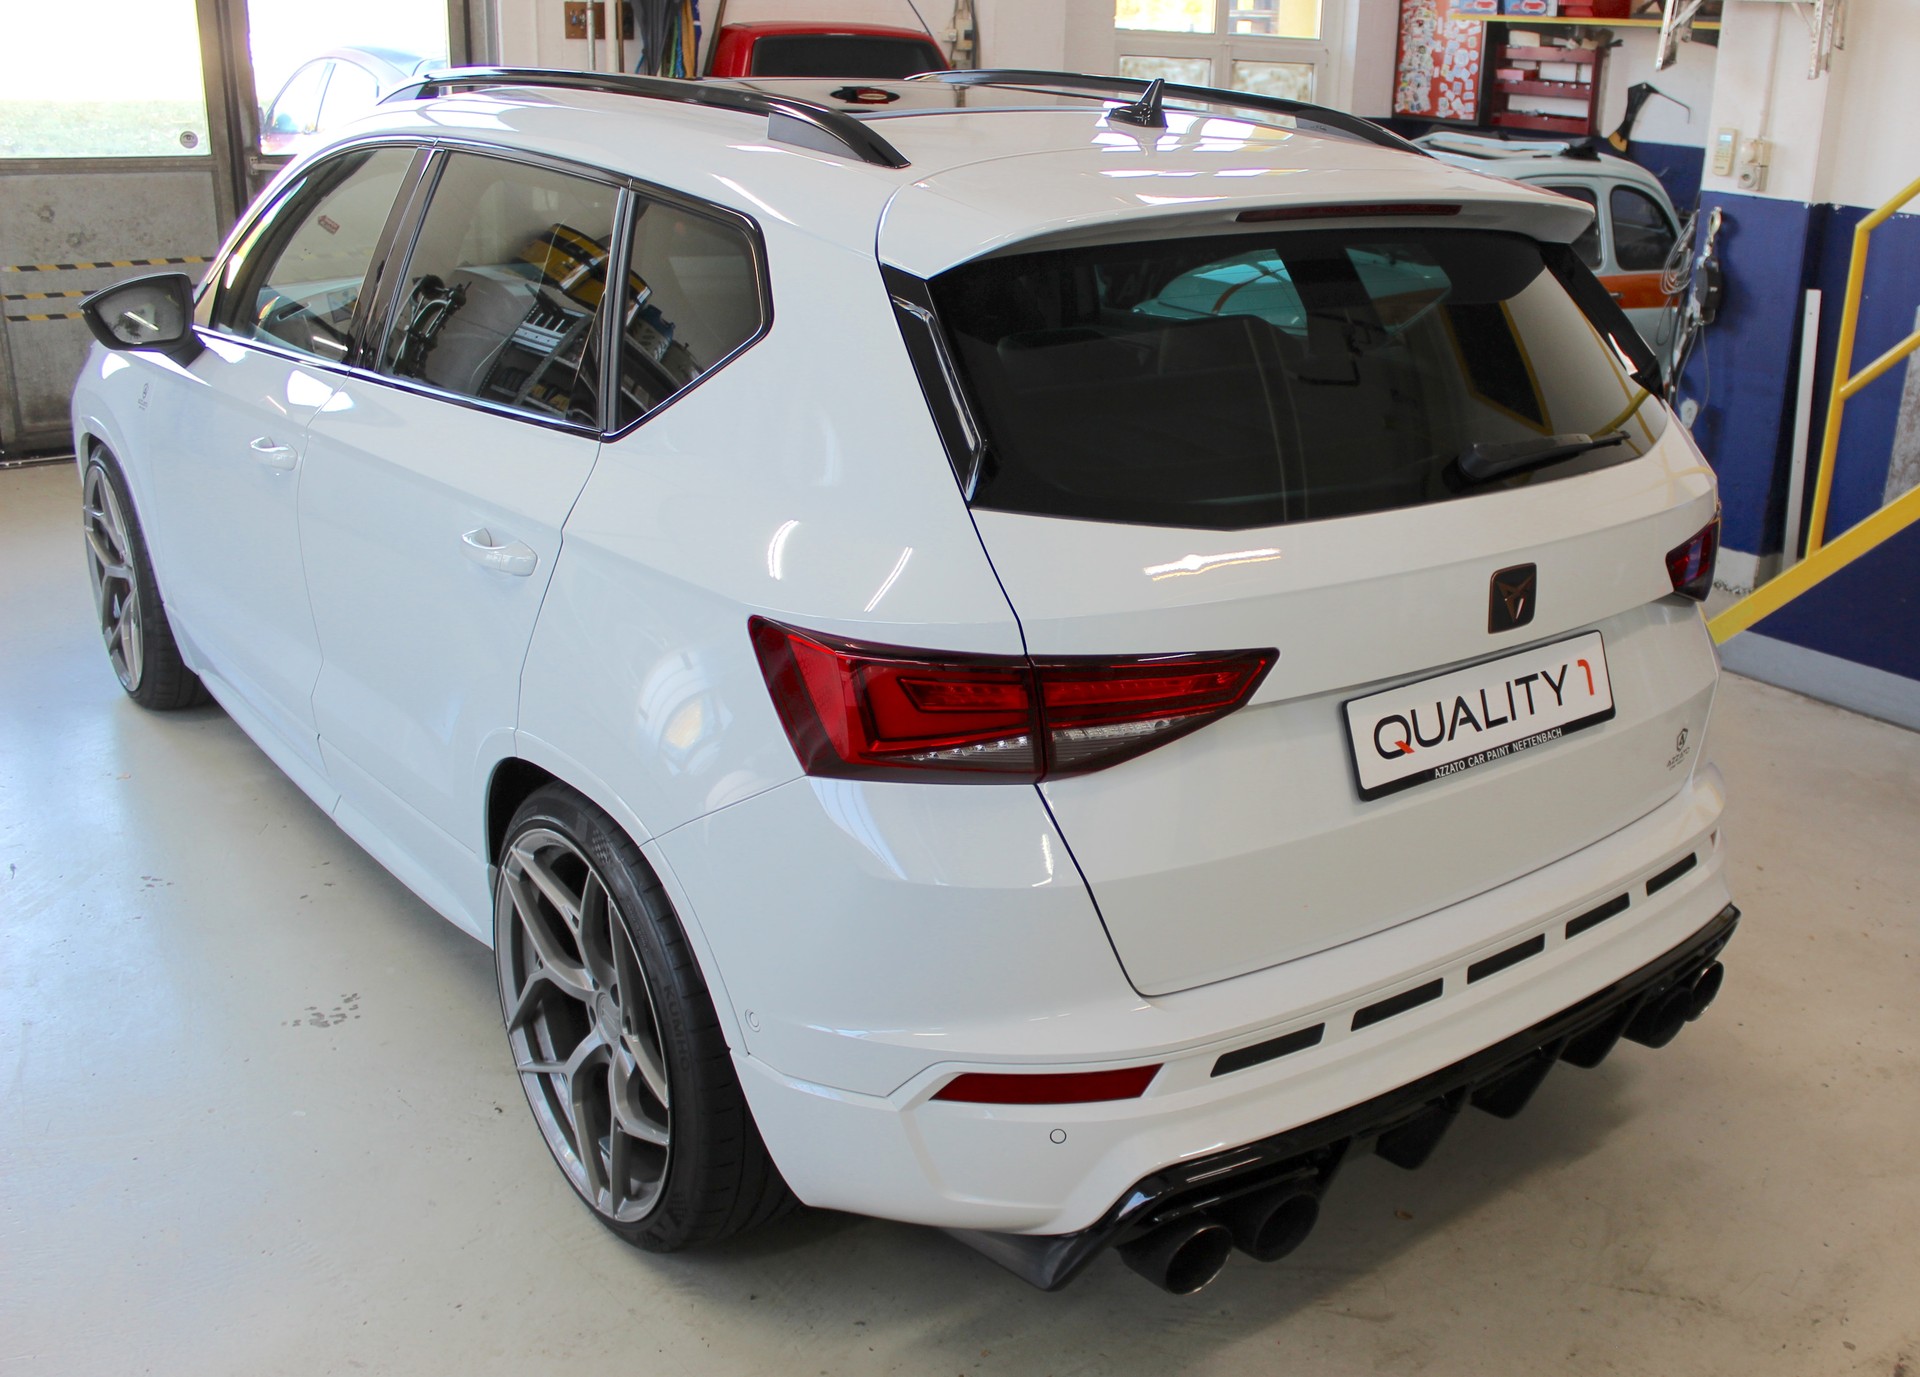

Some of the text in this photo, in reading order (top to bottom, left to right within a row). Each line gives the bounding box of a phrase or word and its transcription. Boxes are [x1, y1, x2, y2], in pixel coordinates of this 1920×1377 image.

[1374, 664, 1568, 760] QUALITY
[1435, 728, 1562, 779] AZZATO CAR PAINT NEFTENBACH
[663, 984, 690, 1071] KUMHO
